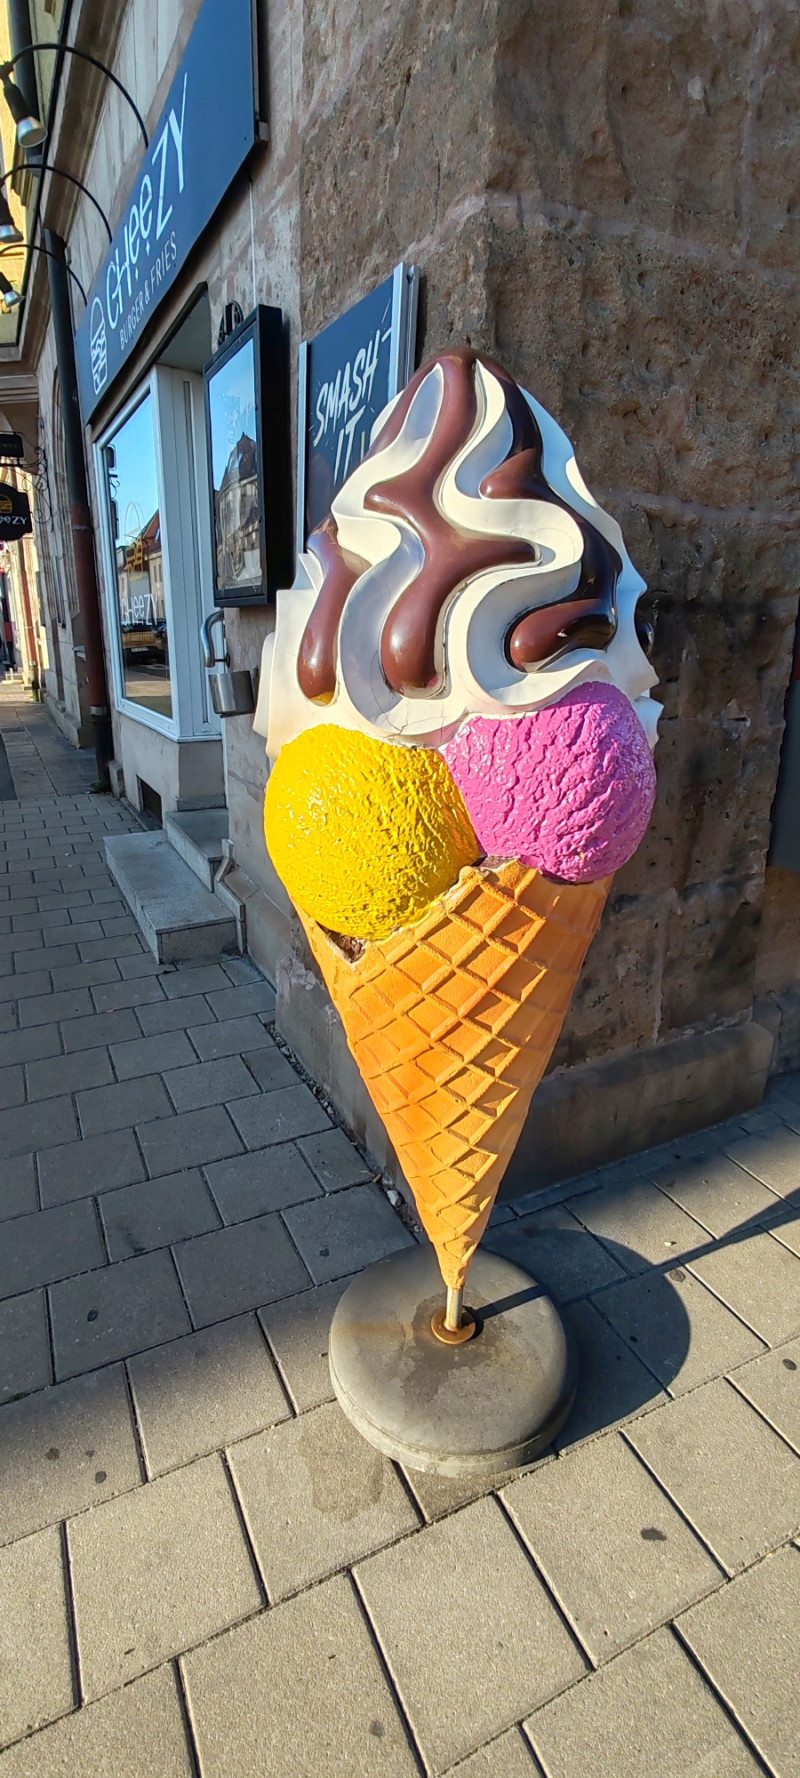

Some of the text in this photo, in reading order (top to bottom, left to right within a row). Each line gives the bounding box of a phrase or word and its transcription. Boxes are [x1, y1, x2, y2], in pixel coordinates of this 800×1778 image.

[119, 231, 177, 351] BURGER & FRIES
[314, 328, 380, 448] SMASH
[333, 405, 366, 487] IT
